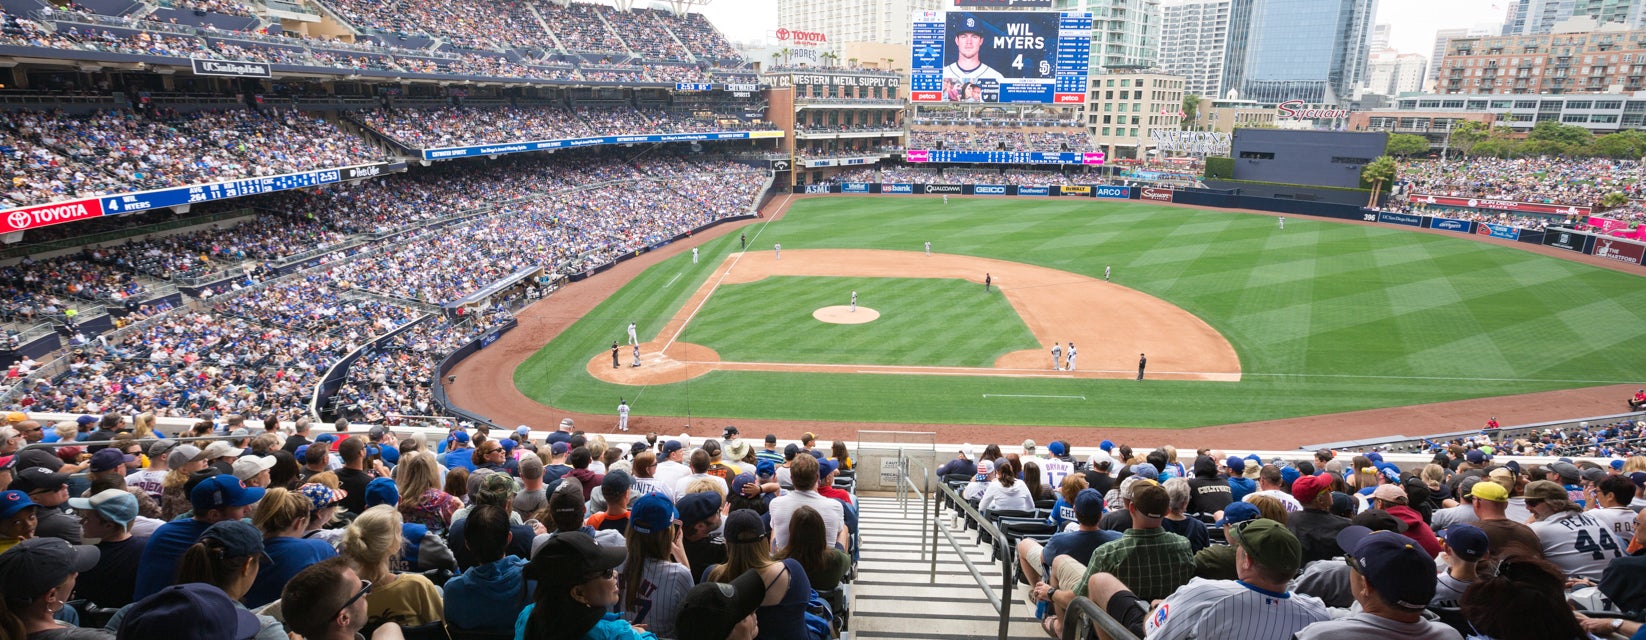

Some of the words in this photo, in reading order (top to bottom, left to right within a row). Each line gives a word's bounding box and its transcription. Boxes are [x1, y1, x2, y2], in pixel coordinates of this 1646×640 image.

[1007, 23, 1033, 36] WIL
[792, 31, 826, 42] TOYOTA
[993, 37, 1044, 49] MYERS
[790, 49, 817, 62] PADRES
[1012, 54, 1024, 70] 4
[793, 75, 829, 85] WESTERN
[833, 76, 857, 86] METAL
[859, 77, 886, 87] SUPPLY
[888, 78, 900, 88] CO.
[1276, 100, 1347, 122] Sycuan
[320, 171, 338, 180] 2:53
[806, 185, 829, 193] ASML
[1097, 188, 1121, 196] ARCO
[109, 200, 119, 211] 4
[31, 203, 88, 224] TOYOTA
[1363, 213, 1376, 221] 396
[1609, 247, 1620, 255] THE
[1608, 253, 1637, 263] HARTFORD
[1046, 463, 1068, 472] BRYANT
[1575, 528, 1622, 560] 44
